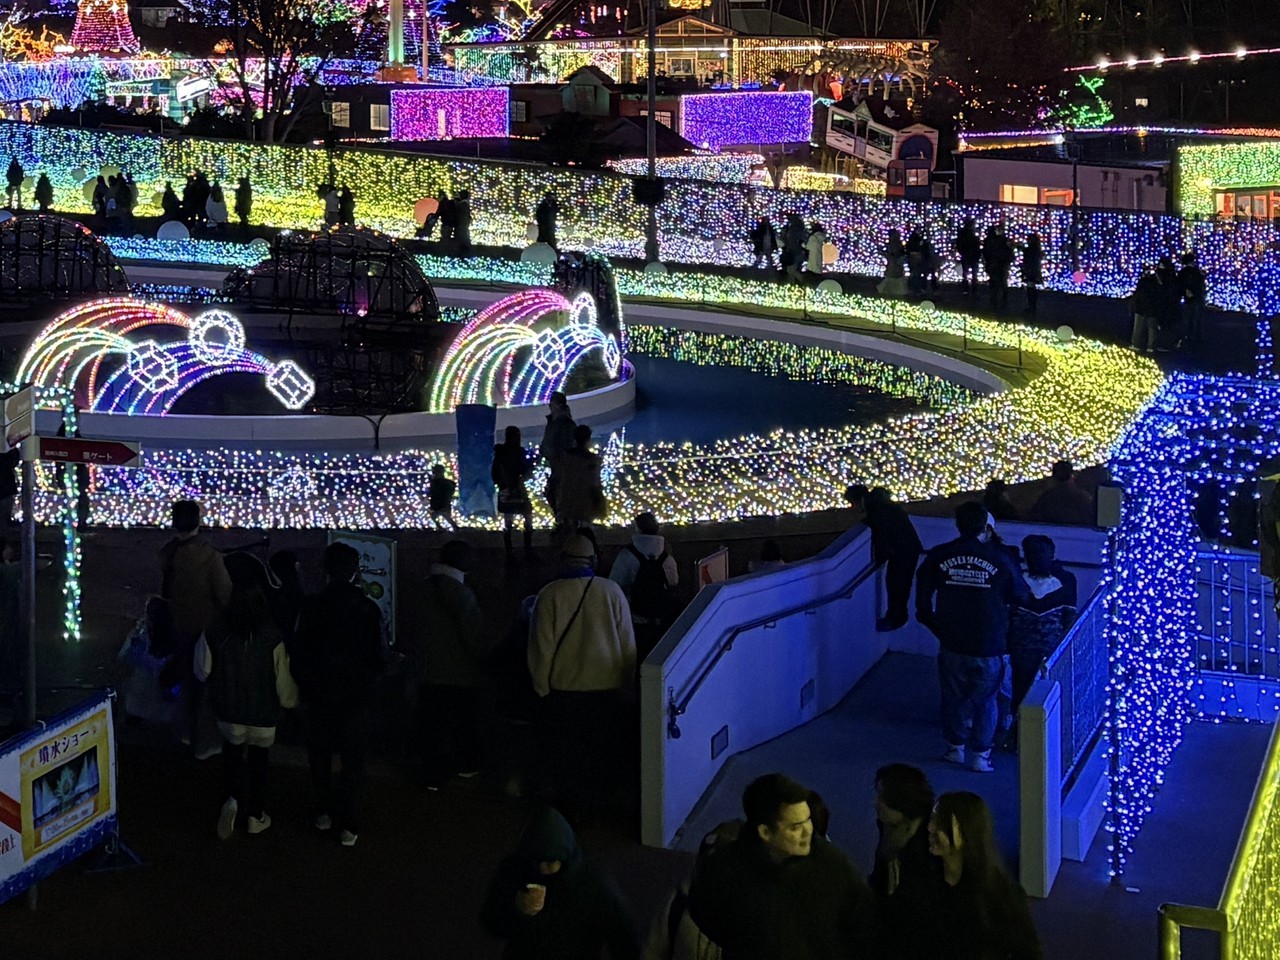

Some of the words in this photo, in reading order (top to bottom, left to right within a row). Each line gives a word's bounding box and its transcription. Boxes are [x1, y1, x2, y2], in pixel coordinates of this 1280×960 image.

[39, 730, 89, 765] 噴水ショー
